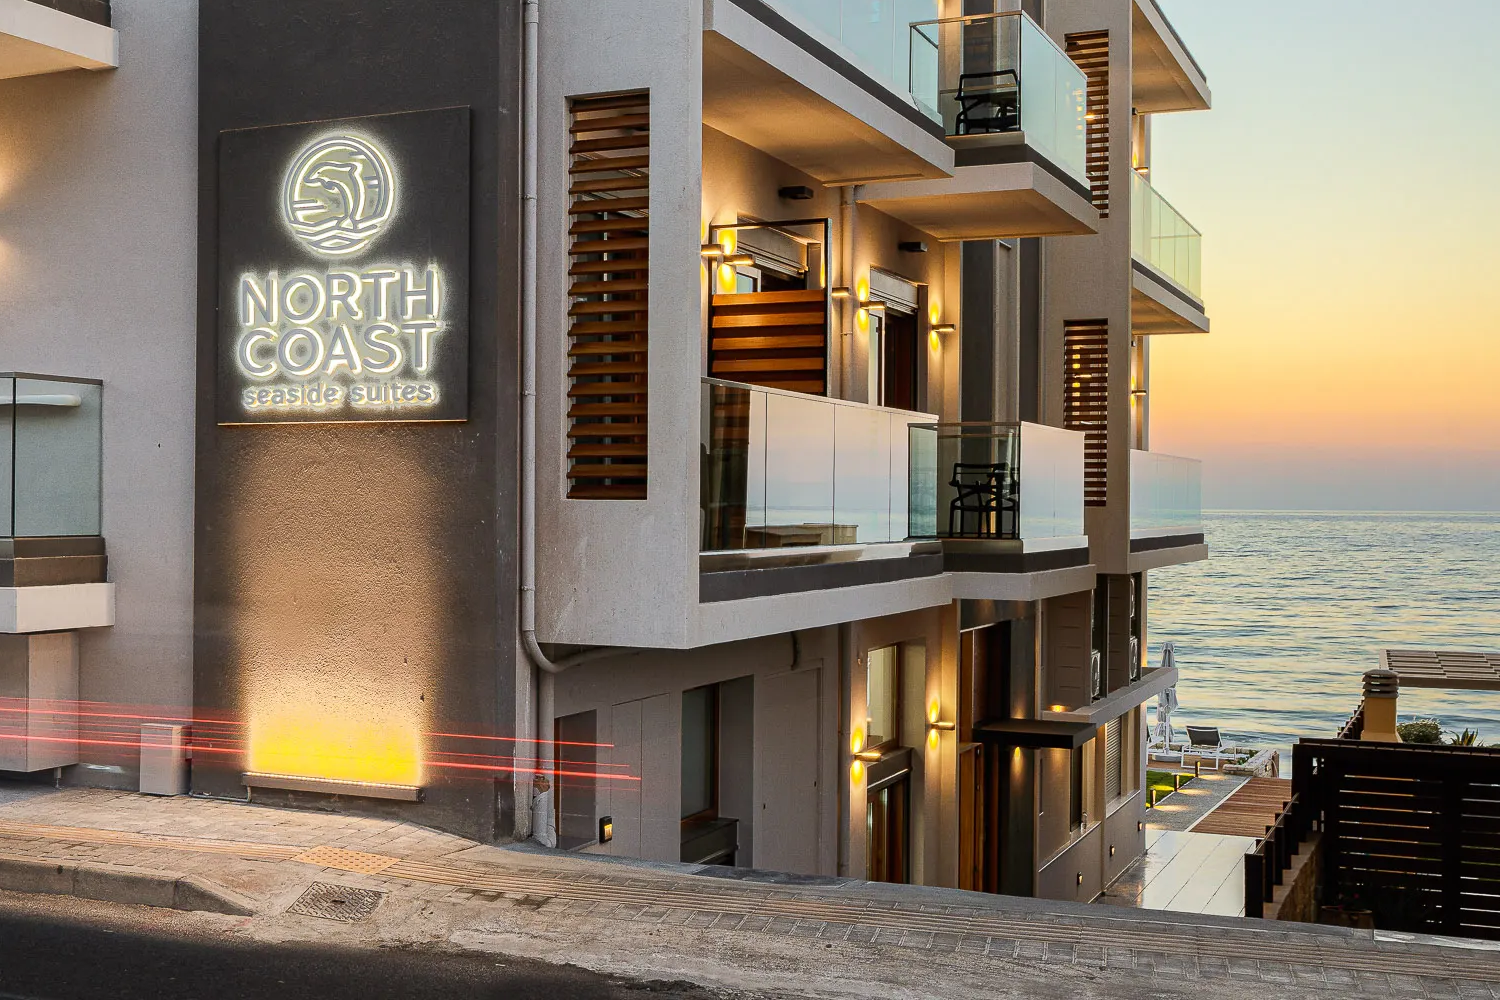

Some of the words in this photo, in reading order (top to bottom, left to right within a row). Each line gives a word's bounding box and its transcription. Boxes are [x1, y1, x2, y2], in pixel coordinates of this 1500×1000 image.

[241, 267, 439, 326] NORTH
[238, 321, 440, 377] COAST
[243, 382, 339, 407] seaside
[350, 382, 434, 406] suites
